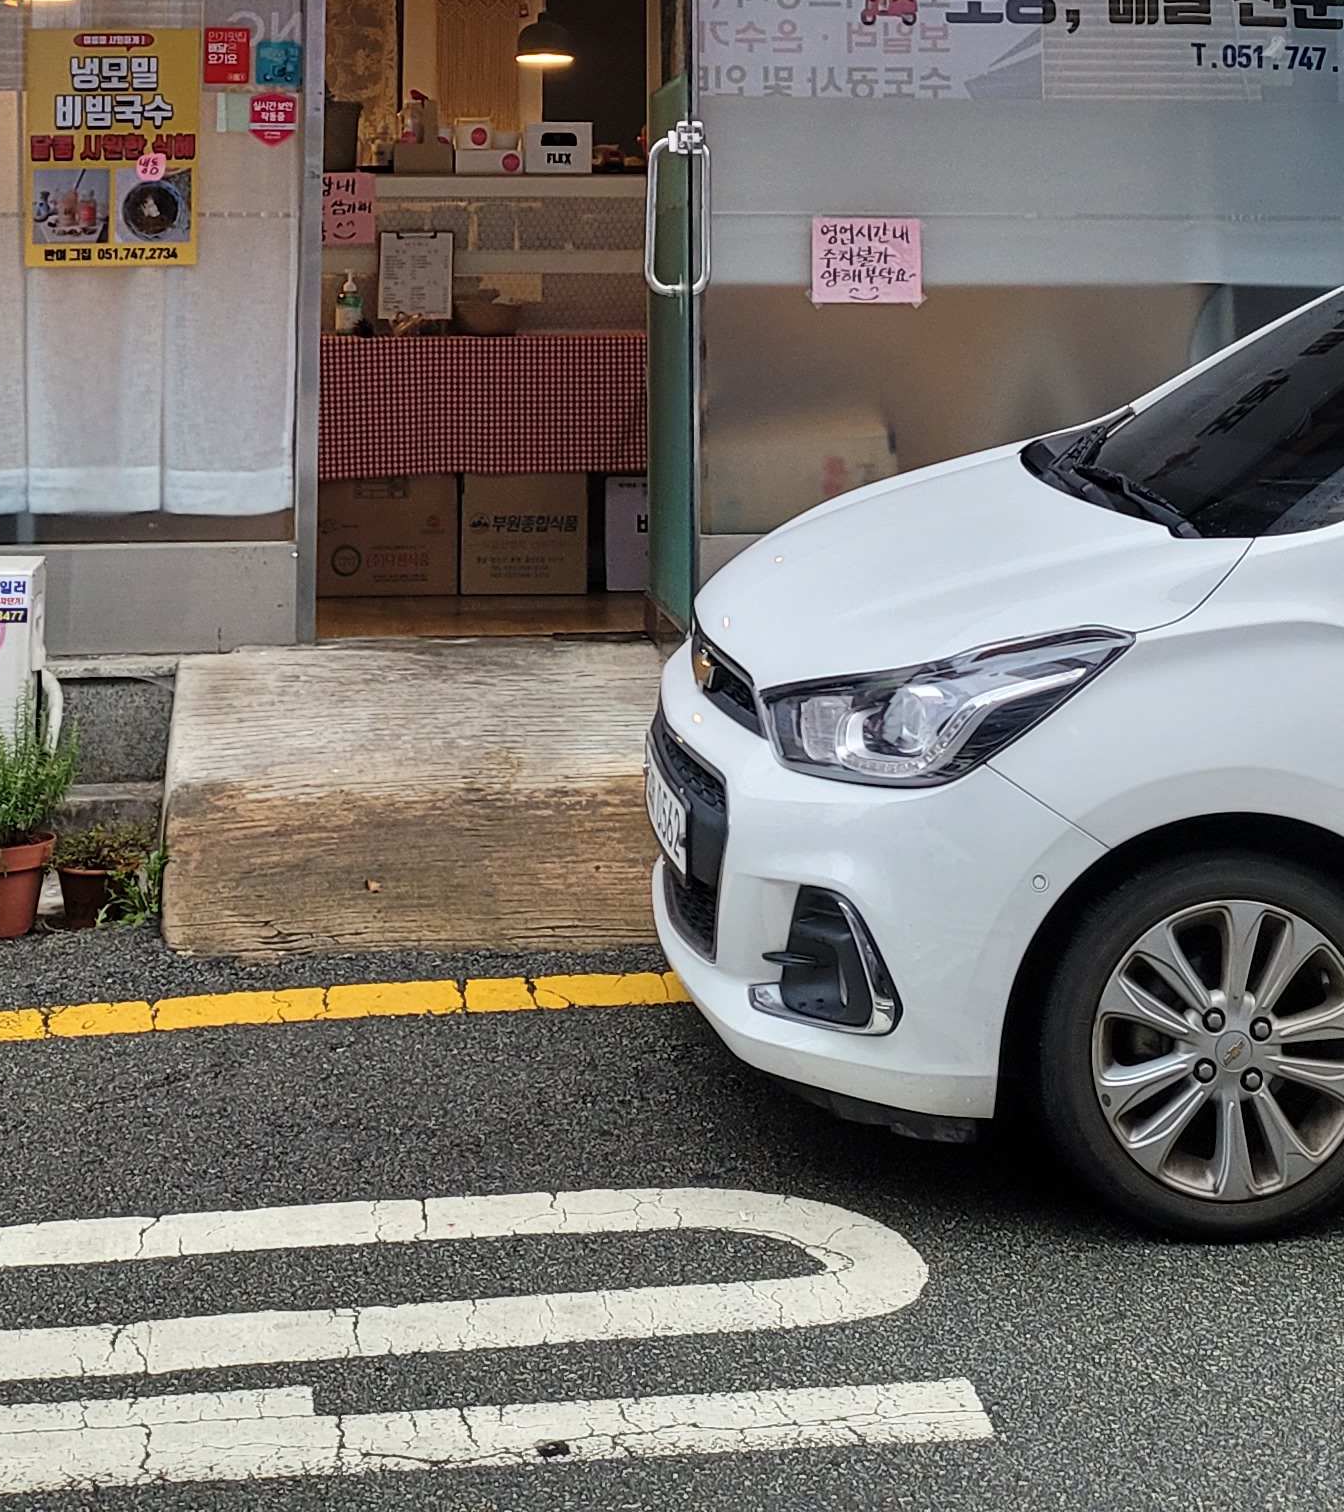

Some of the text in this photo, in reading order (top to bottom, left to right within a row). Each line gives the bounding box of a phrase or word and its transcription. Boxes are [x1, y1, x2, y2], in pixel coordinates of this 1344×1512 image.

[208, 53, 237, 65] 요기요
[70, 56, 158, 91] 냉모밀
[55, 94, 174, 130] 비빔국수
[546, 152, 571, 165] FLEX
[97, 247, 178, 261] 051.747.2734
